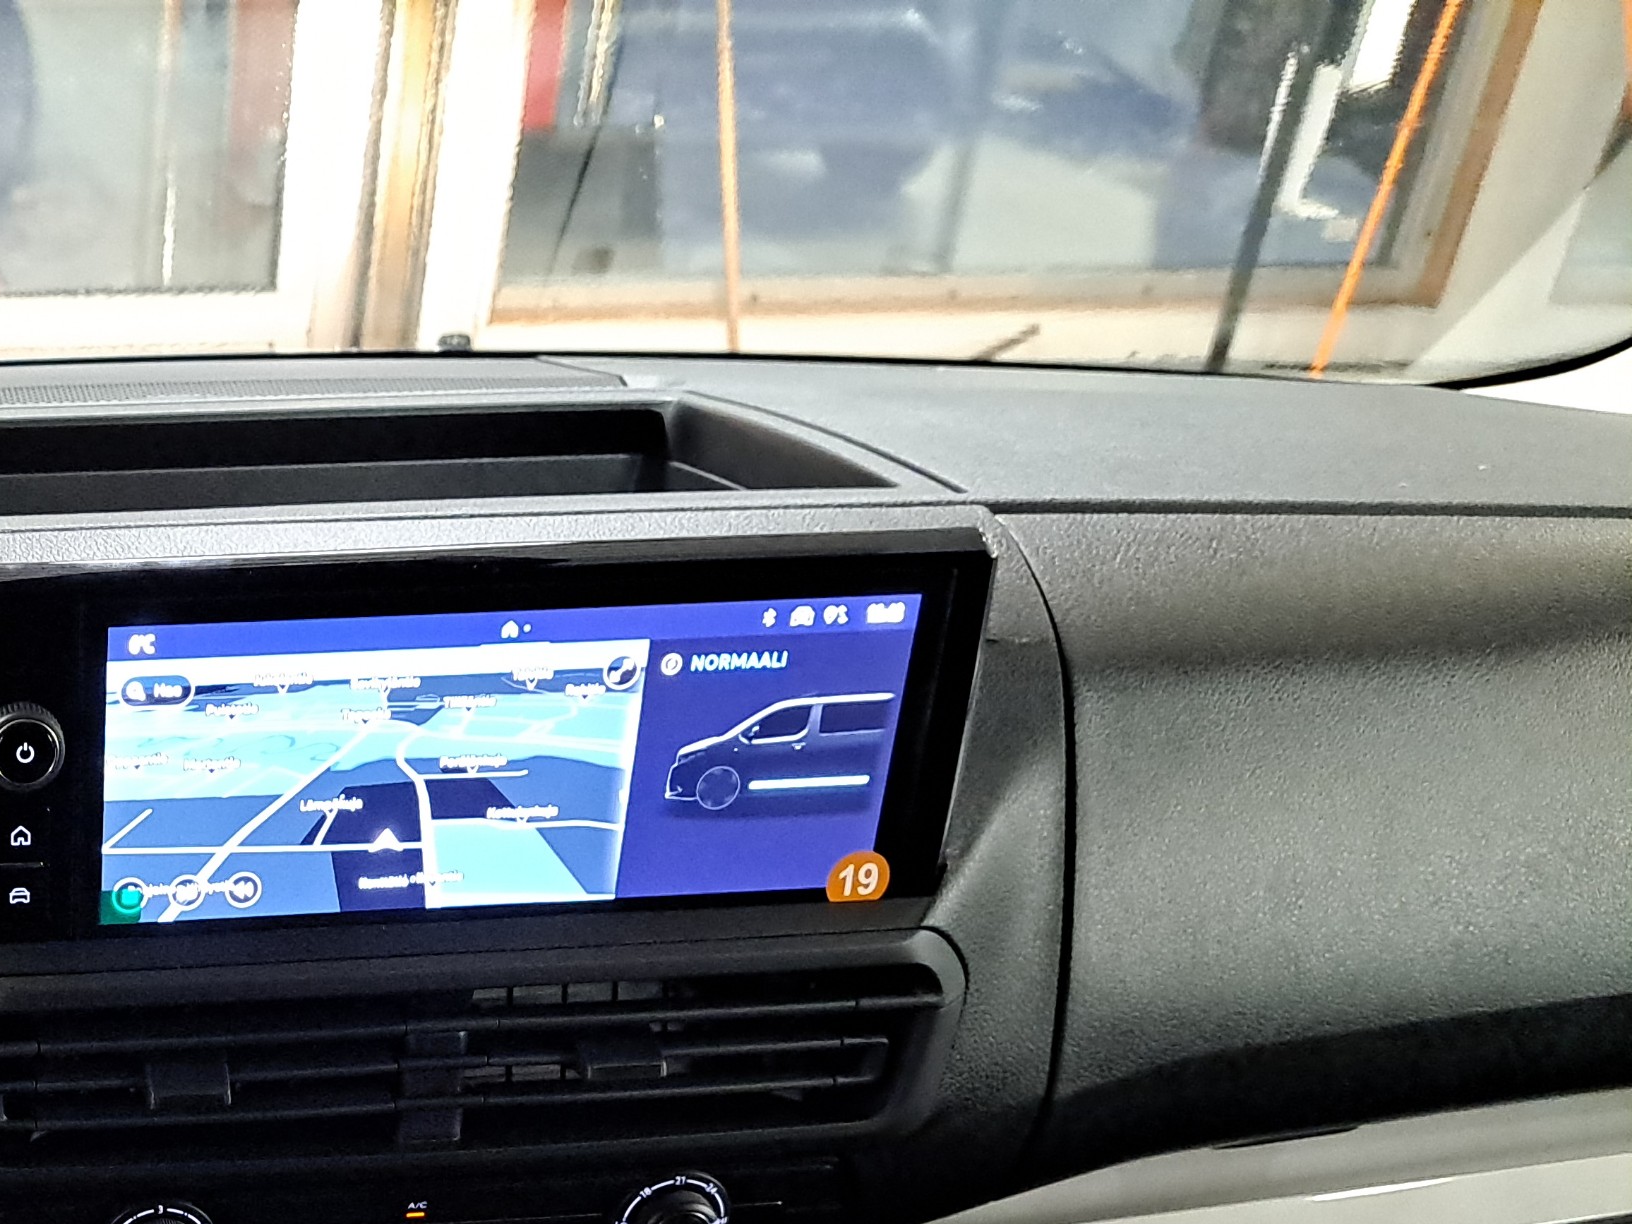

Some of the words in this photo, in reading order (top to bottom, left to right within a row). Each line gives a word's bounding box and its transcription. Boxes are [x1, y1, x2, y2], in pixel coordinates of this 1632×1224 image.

[689, 651, 788, 672] NORMAALI
[838, 862, 879, 897] 19
[408, 1201, 428, 1209] A/C
